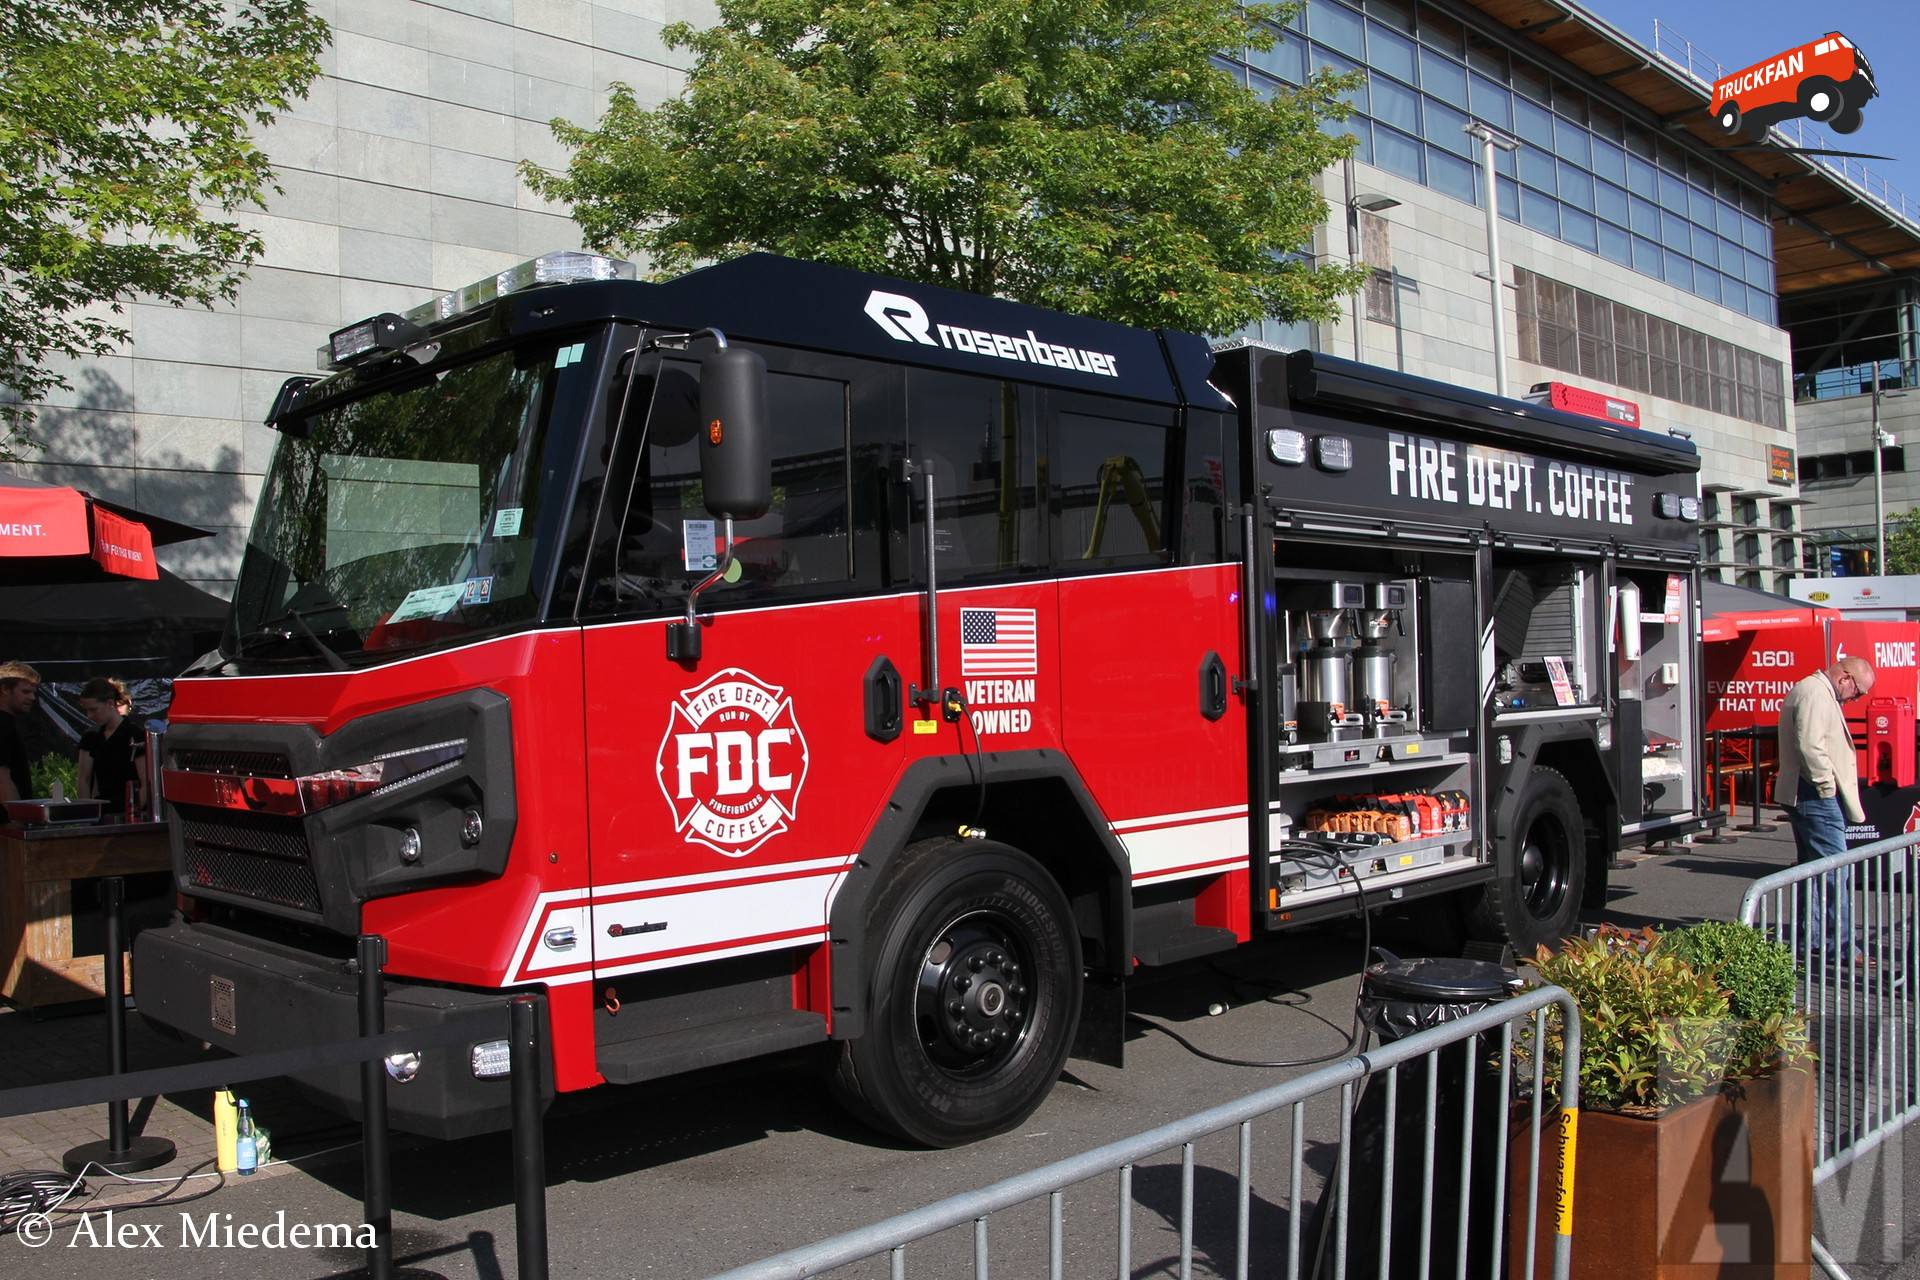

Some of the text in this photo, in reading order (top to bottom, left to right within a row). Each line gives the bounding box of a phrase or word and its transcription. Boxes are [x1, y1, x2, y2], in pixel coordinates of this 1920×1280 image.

[937, 323, 1119, 378] rosenbauer
[1388, 432, 1634, 525] FIRE DEPT. COFFEE
[0, 523, 46, 537] MENT.
[1752, 650, 1789, 667] 160
[1874, 641, 1916, 668] FANZONE
[964, 679, 1036, 705] VETERAN
[1707, 680, 1795, 695] EVERYTHIN
[693, 687, 770, 718] FIRE DEPT.
[1718, 697, 1756, 712] THAT
[719, 710, 750, 723] RUN BY
[971, 708, 1032, 736] OWNED
[674, 726, 793, 800] FDC
[708, 793, 763, 815] FIREFIGHTERS
[704, 813, 768, 840] COFFEE
